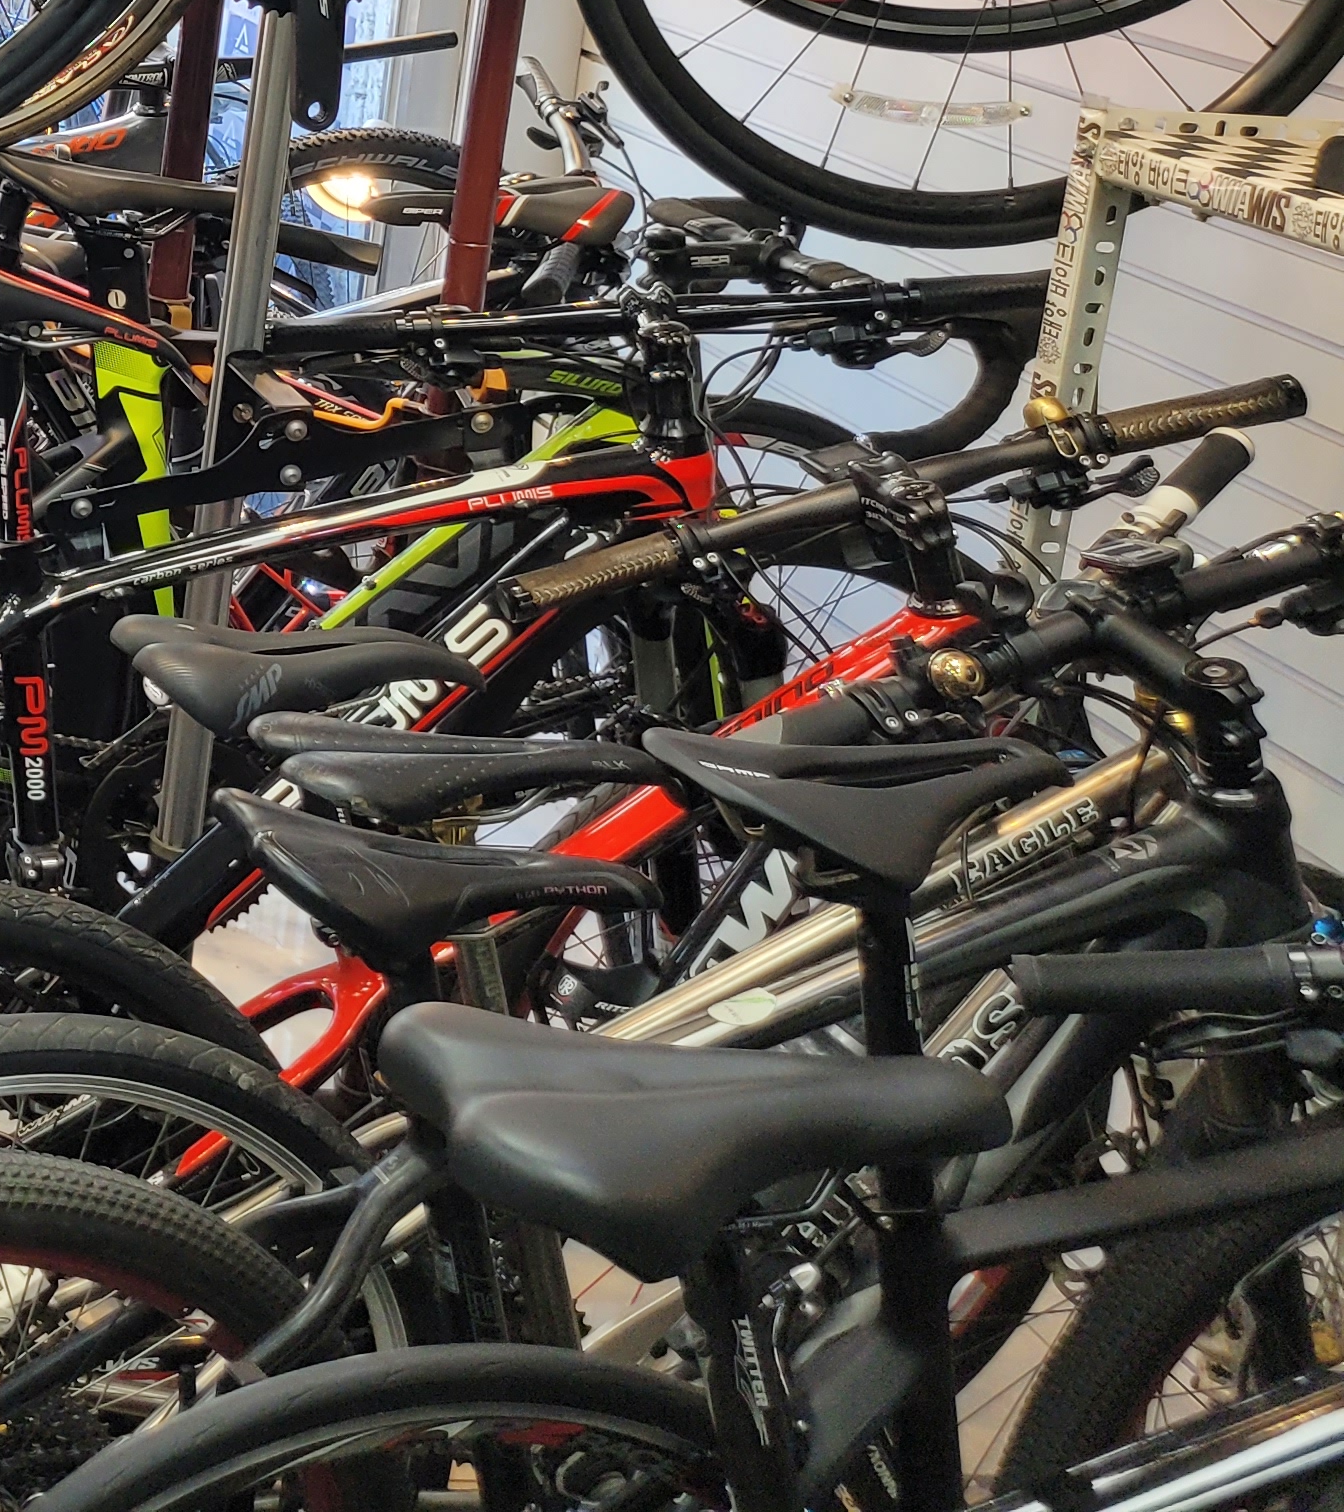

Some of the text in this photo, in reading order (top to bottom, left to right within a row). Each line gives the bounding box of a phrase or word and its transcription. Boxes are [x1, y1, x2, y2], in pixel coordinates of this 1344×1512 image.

[1147, 154, 1191, 197] 바이크
[104, 326, 158, 349] PLUMIS
[467, 485, 554, 511] PLUMIS
[132, 554, 234, 586] carbon series
[13, 675, 49, 802] PM 2000
[948, 796, 1100, 895] EAGLE
[737, 1313, 770, 1408] TWITTER
